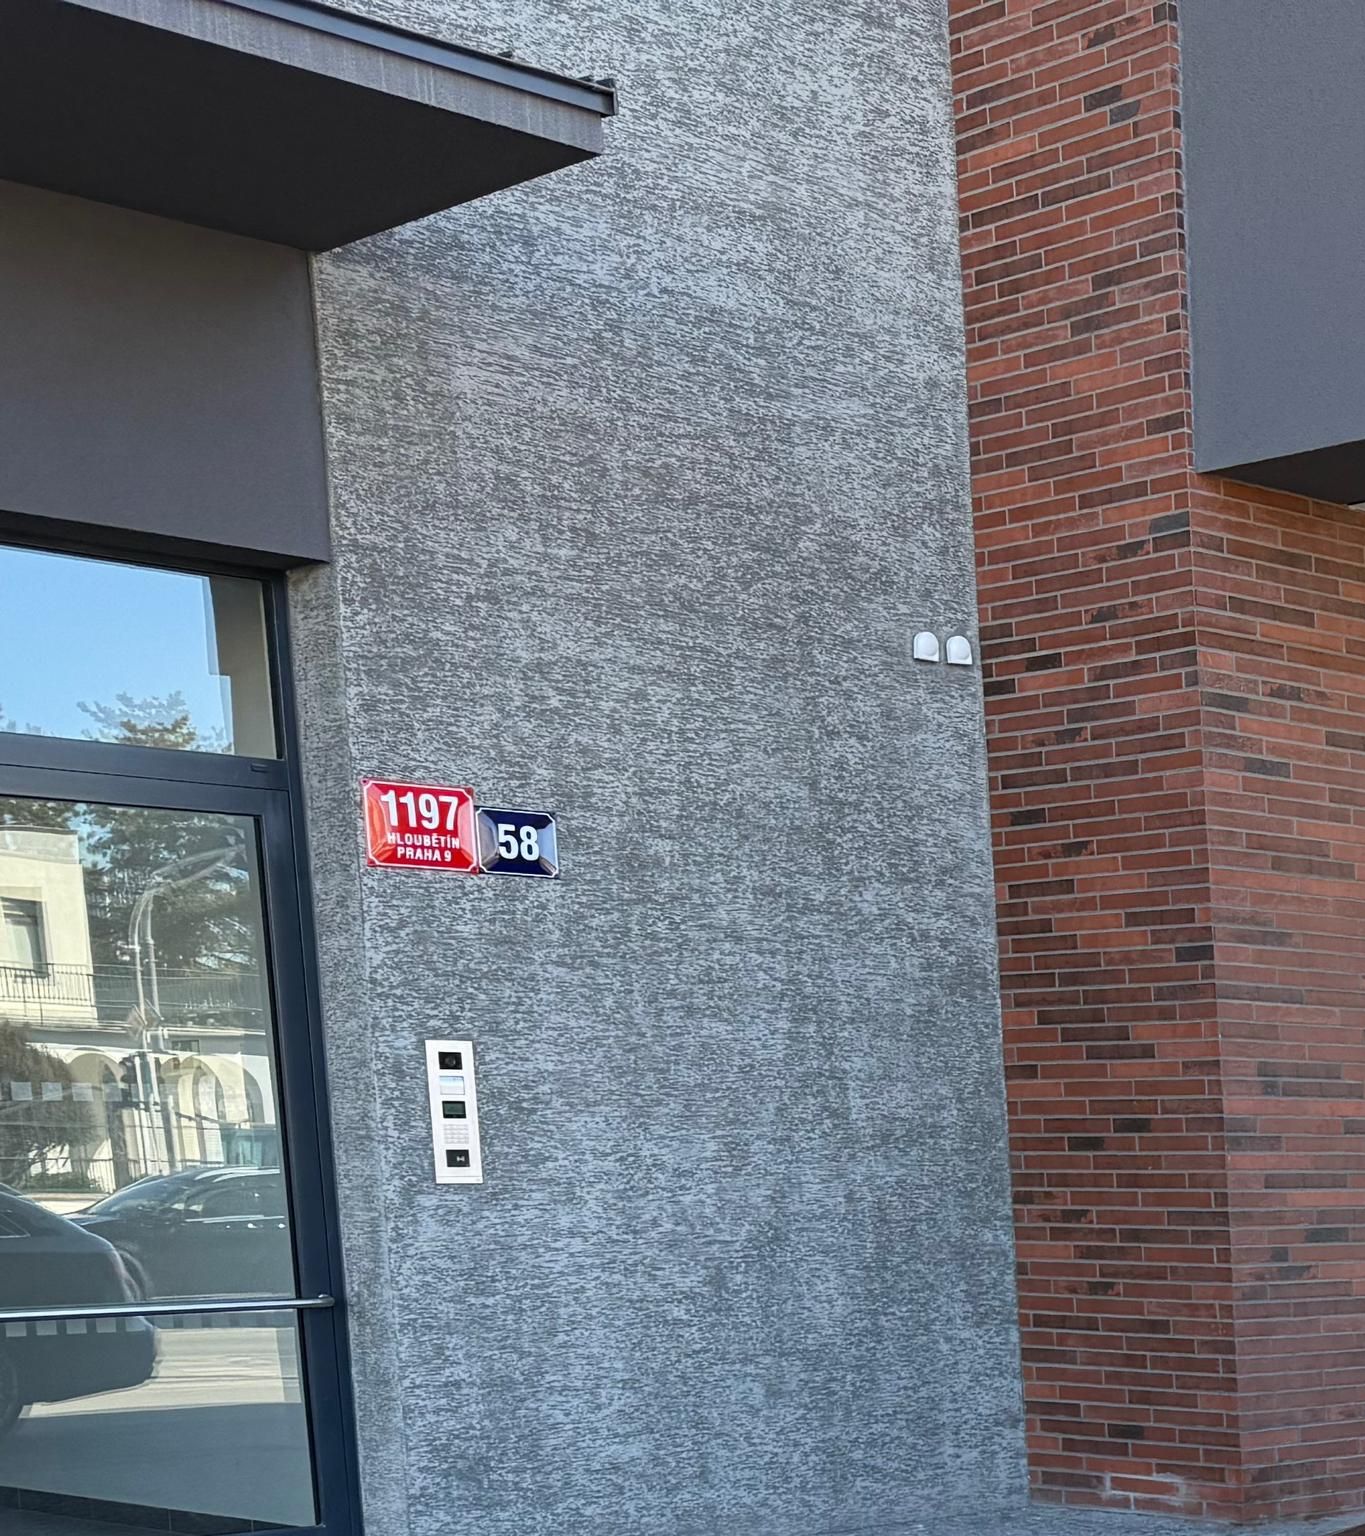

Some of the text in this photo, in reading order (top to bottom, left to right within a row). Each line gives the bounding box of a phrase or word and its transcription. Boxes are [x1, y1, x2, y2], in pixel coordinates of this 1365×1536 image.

[380, 789, 459, 830] 1197
[387, 831, 460, 849] HLOUBĚTÍN
[397, 846, 452, 862] PRAHA 9
[497, 823, 540, 861] 58
